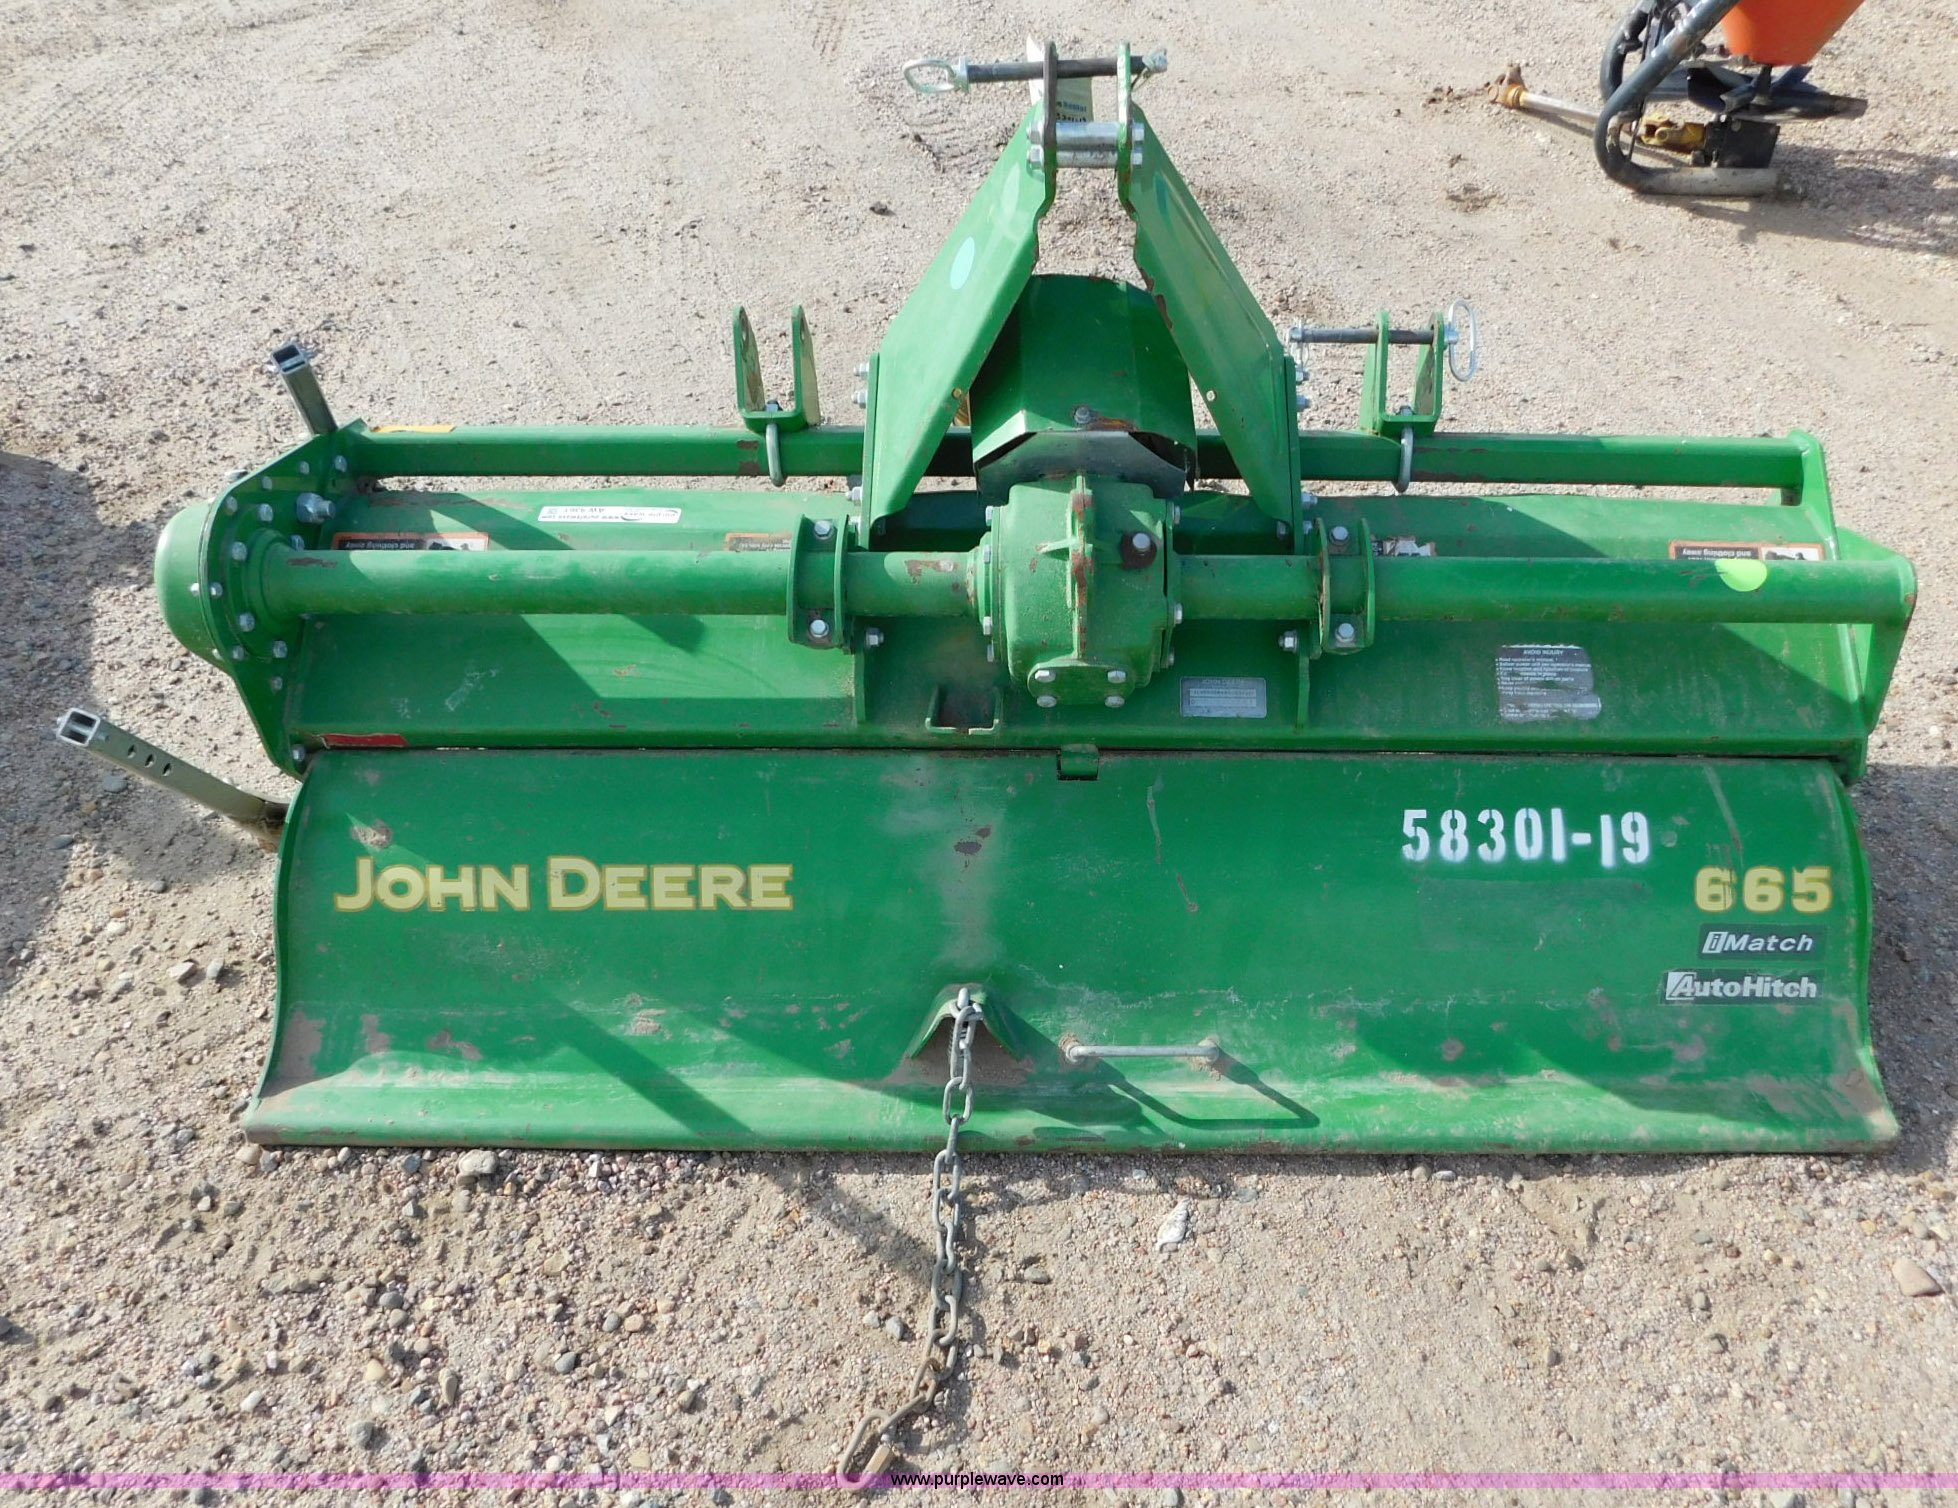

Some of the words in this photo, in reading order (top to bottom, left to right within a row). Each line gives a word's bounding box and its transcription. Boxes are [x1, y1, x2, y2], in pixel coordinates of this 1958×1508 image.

[1401, 807, 1652, 868] 58301-19
[334, 855, 531, 912] JOHN
[547, 854, 794, 911] DEERE
[1694, 865, 1834, 914] 665
[1702, 931, 1814, 955] iMatch
[1665, 971, 1818, 1001] AutoHitch
